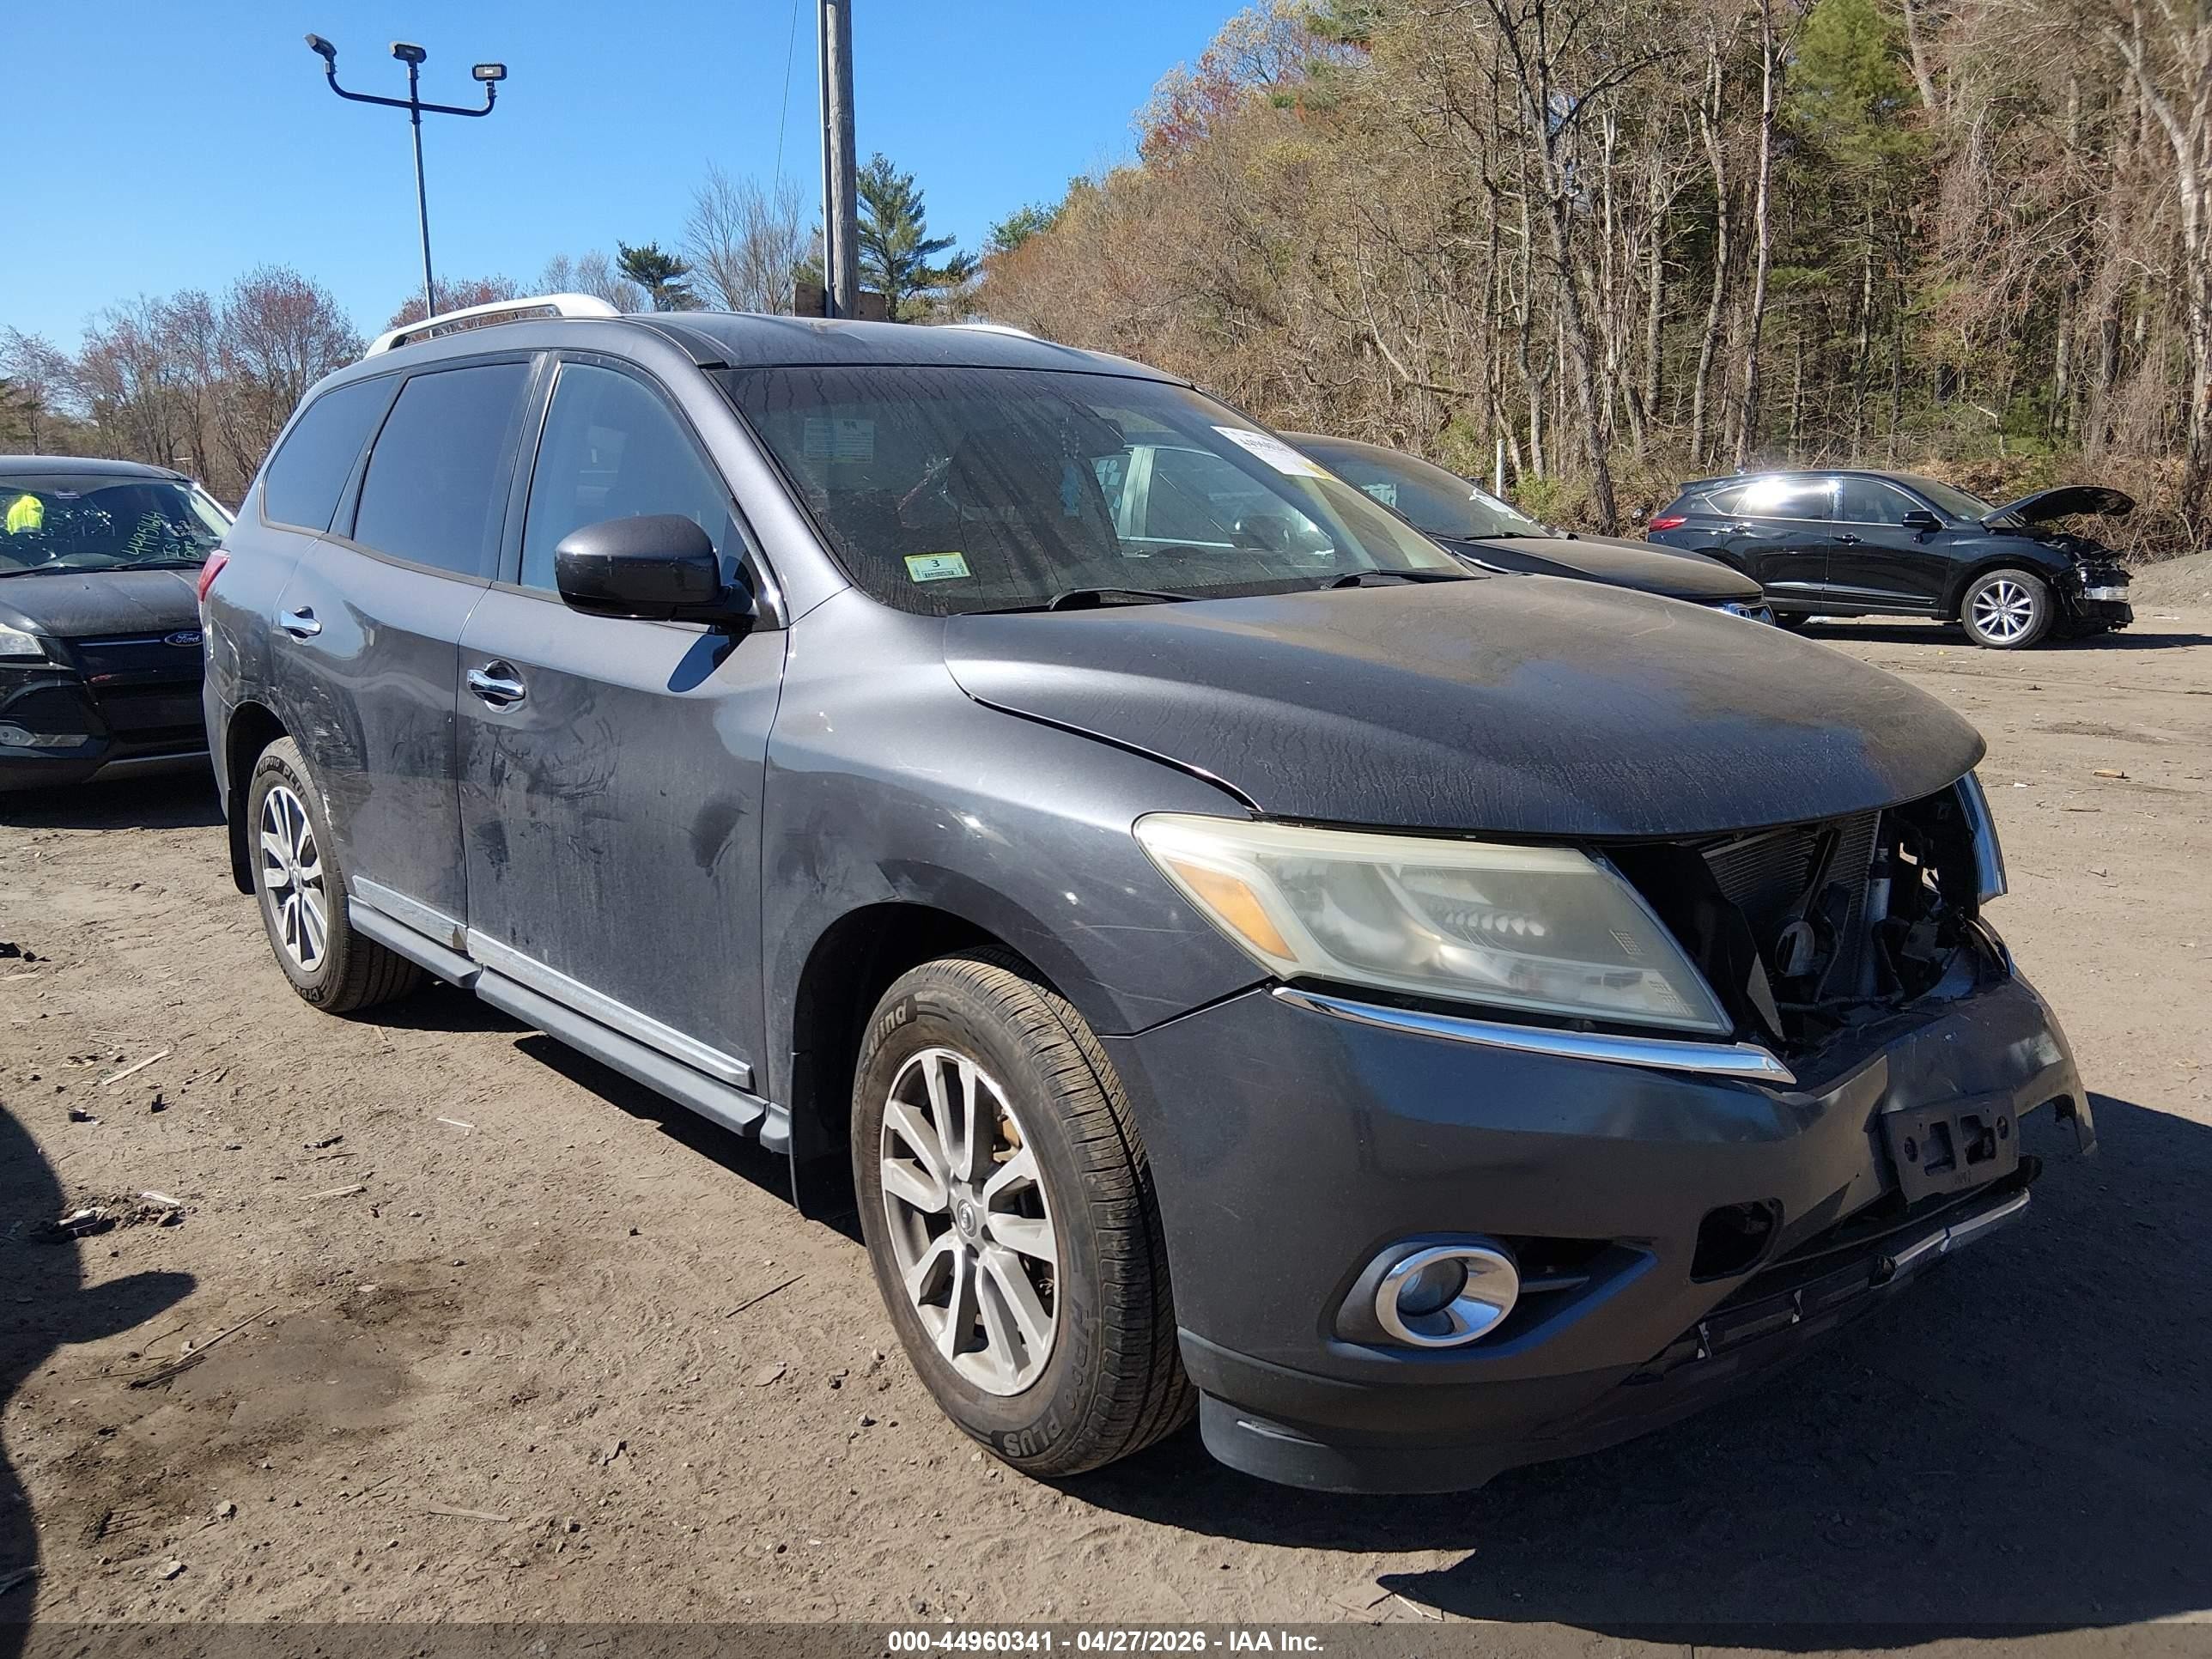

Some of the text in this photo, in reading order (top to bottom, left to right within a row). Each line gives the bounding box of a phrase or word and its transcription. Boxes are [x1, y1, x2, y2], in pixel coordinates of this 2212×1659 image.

[931, 559, 940, 568] 3
[176, 633, 200, 643] Ford
[1003, 1407, 1065, 1457] PLUS
